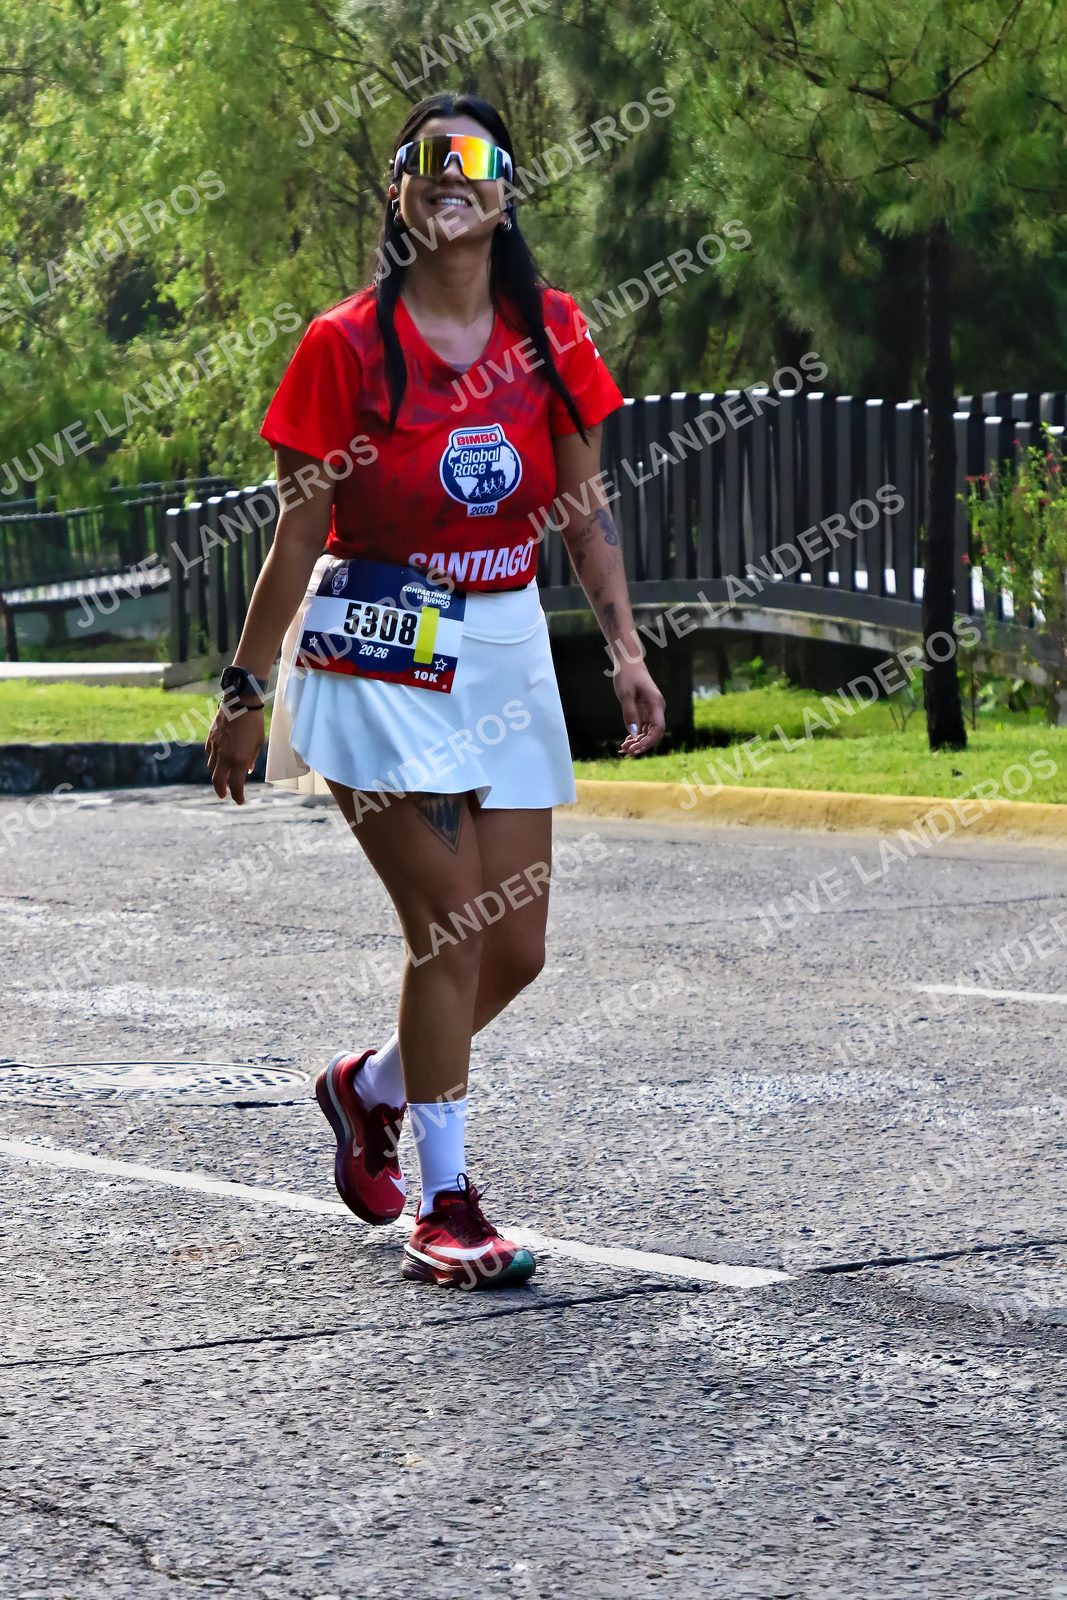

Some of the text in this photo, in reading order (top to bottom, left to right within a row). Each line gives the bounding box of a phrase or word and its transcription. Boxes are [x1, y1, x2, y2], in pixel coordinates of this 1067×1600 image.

[456, 433, 498, 446] BIMBO
[461, 447, 500, 464] Global
[453, 463, 486, 477] Race
[470, 505, 495, 516] 2026
[343, 602, 418, 646] 5308
[413, 669, 439, 683] 10K
